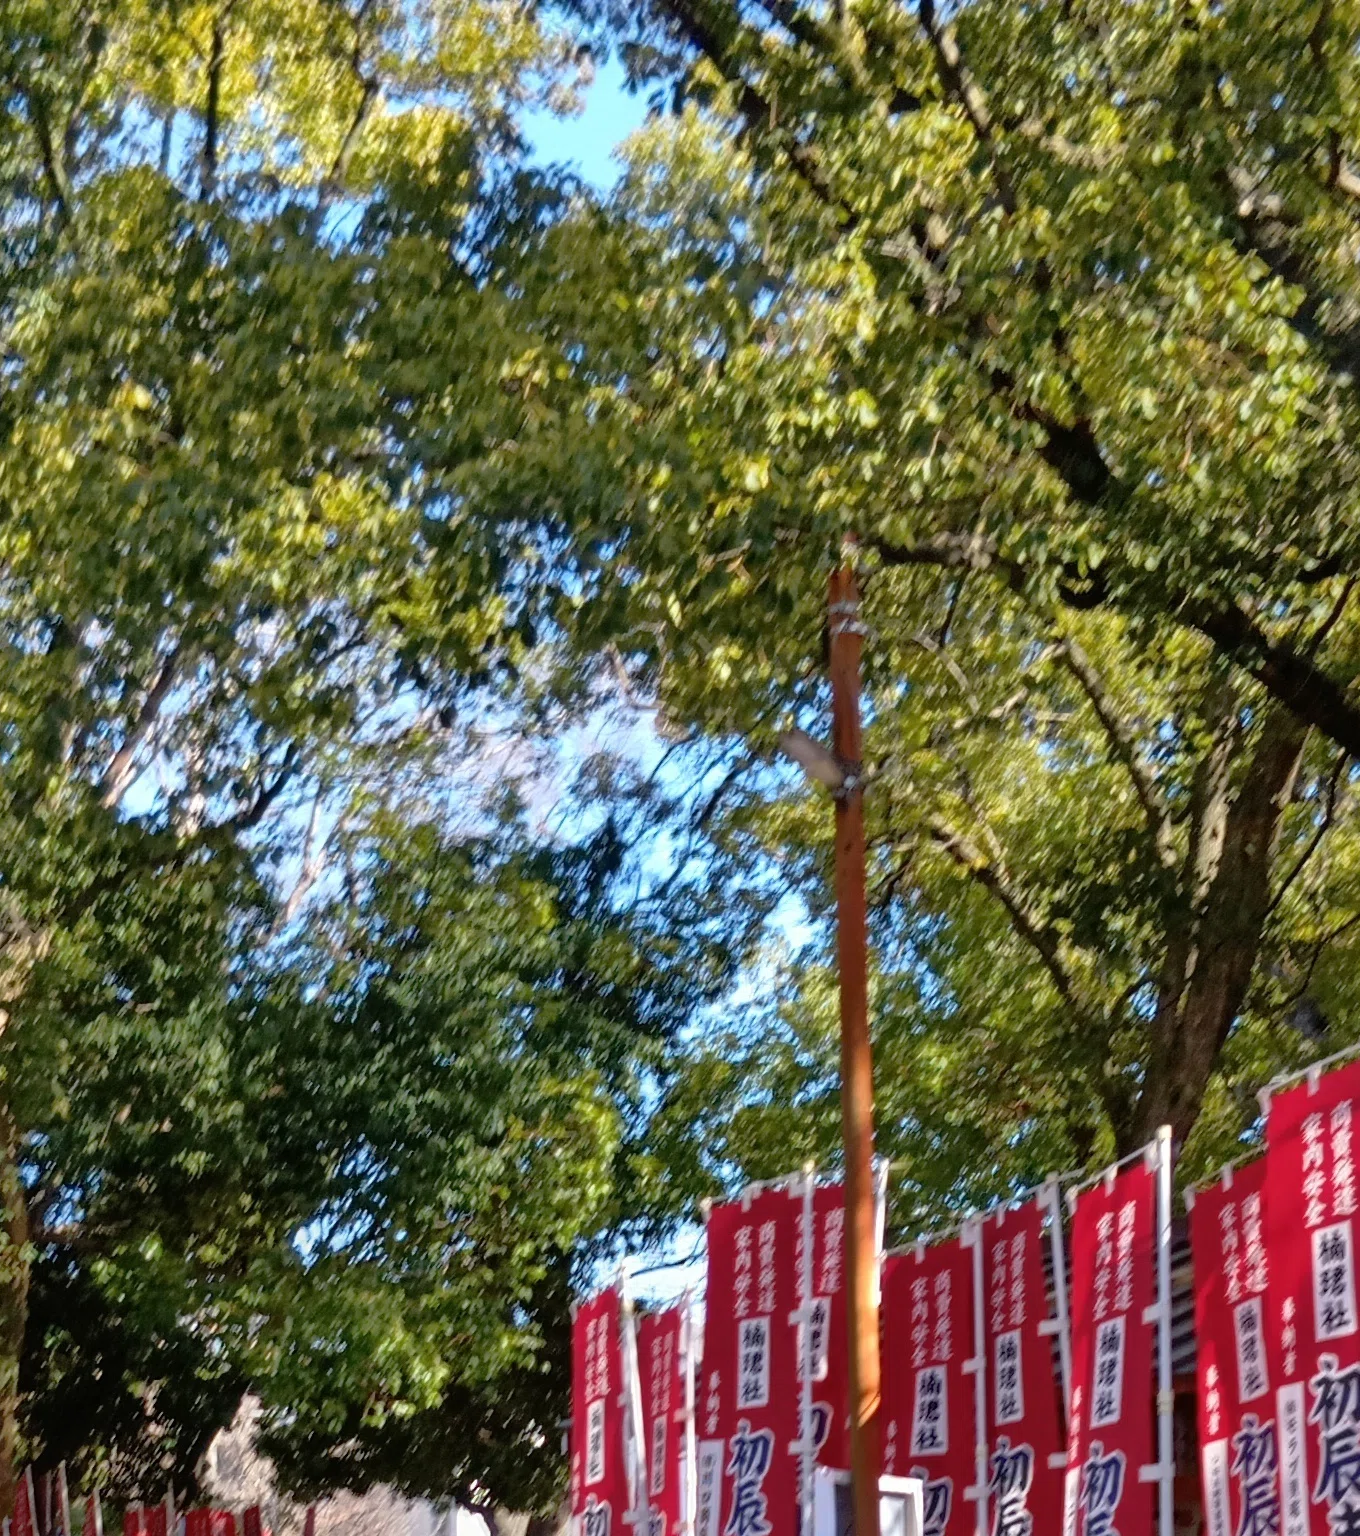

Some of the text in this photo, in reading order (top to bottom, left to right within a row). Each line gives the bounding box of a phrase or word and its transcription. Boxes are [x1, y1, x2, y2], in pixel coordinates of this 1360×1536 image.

[1300, 1112, 1327, 1229] 家内安全
[733, 1225, 754, 1319] 家内安全
[1093, 1211, 1115, 1322] 家内安全
[1218, 1202, 1243, 1305] 家内安全
[1318, 1229, 1352, 1335] 楠珺社
